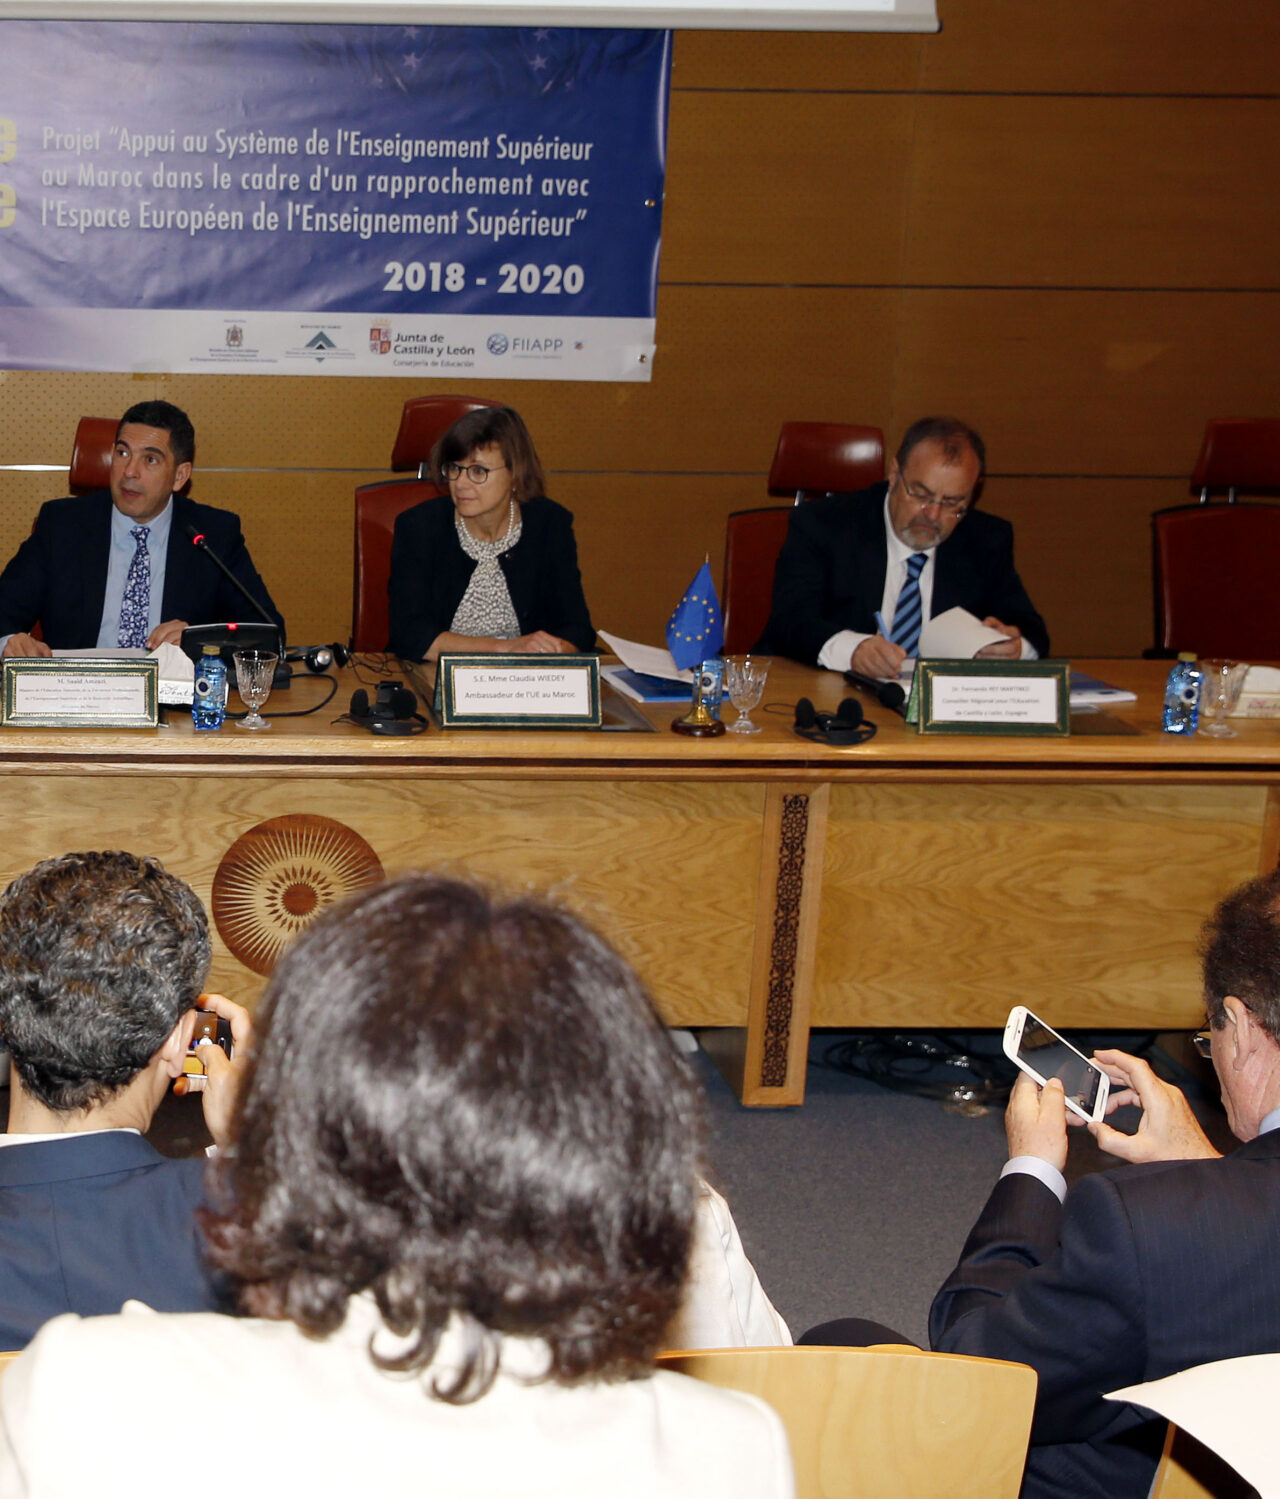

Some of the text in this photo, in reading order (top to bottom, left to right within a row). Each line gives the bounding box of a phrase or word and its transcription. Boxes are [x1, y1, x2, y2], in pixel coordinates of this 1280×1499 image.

[42, 126, 101, 156] Projet
[182, 133, 208, 153] au
[215, 129, 298, 160] Système
[305, 128, 329, 155] de
[336, 129, 490, 163] l'Enseignement
[496, 134, 593, 166] Supérieur
[41, 162, 590, 199] au Maroc dans le cadre d'un rapprochement avec
[41, 197, 131, 234] l'Espace
[139, 202, 244, 237] Européen
[252, 201, 279, 231] de
[287, 202, 458, 240] l'Enseignement
[382, 261, 585, 295] 2018 - 2020
[394, 332, 444, 344] Junta de
[512, 338, 563, 351] FIIAPP
[393, 344, 475, 357] Castilla y León
[431, 359, 439, 367] de
[536, 674, 566, 682] WIEDEY
[464, 691, 513, 699] Ambassadeur
